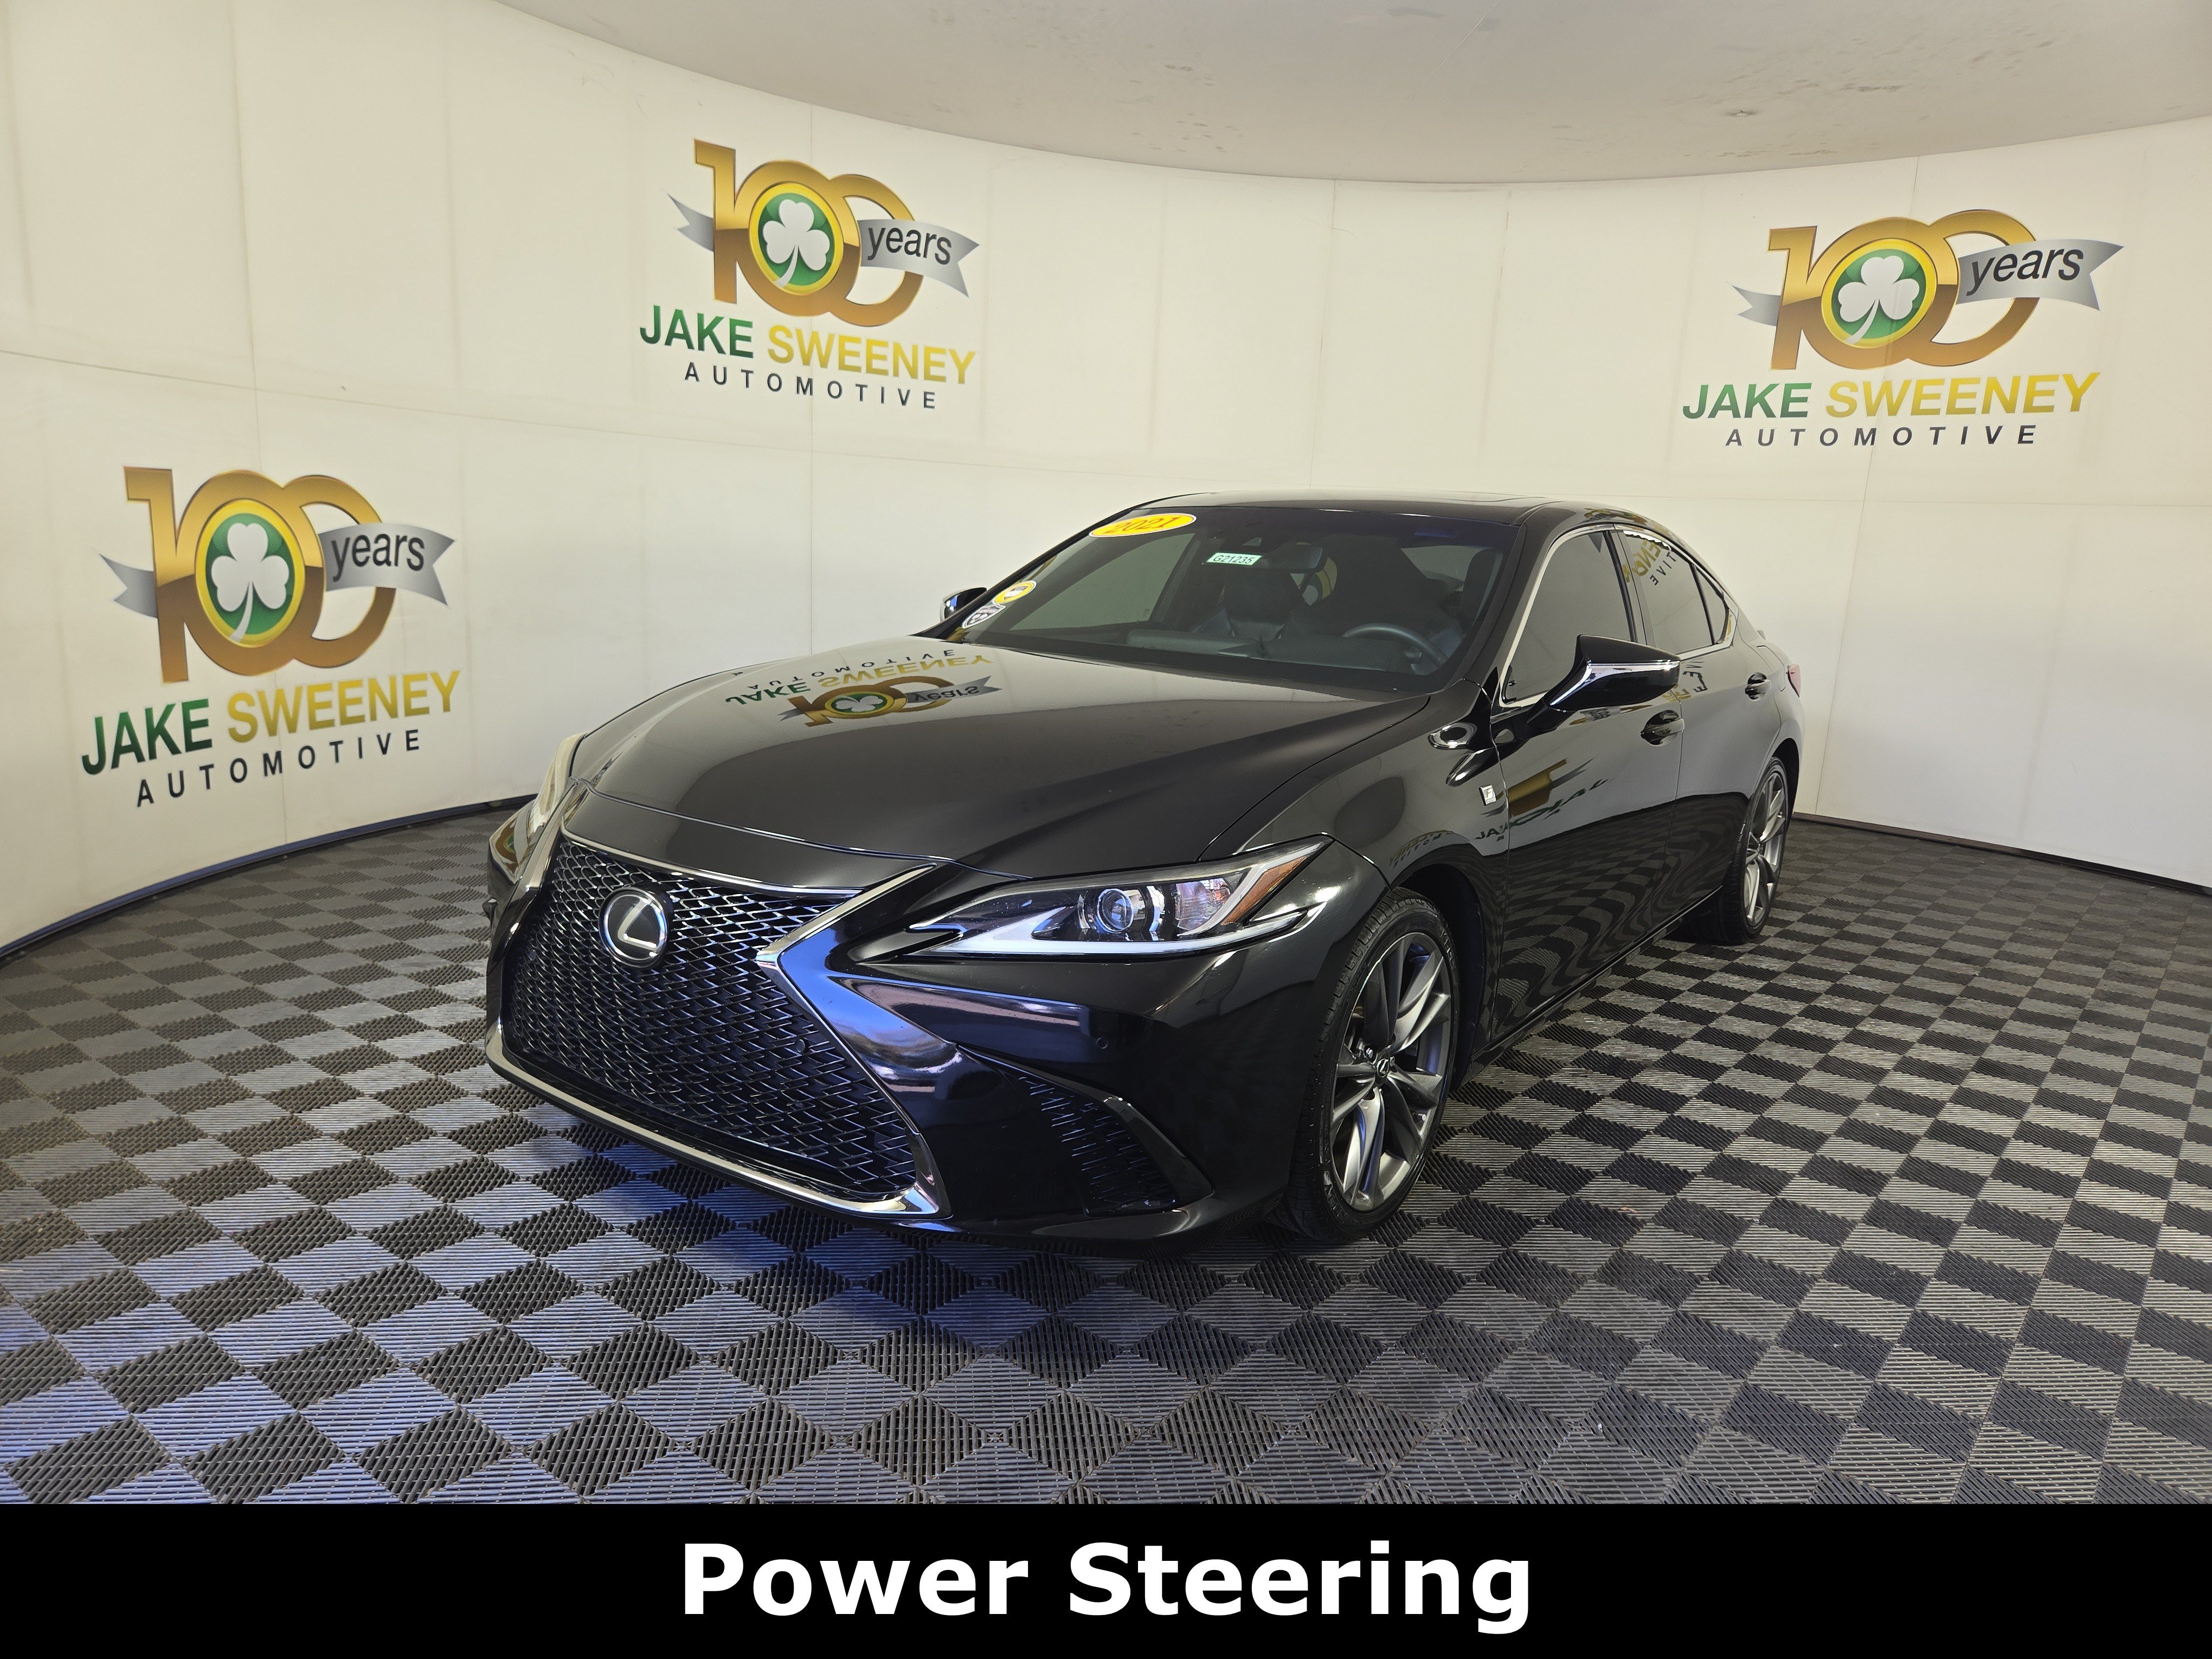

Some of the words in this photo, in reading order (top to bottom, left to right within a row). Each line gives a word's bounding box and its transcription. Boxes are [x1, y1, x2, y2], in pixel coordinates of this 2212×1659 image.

[867, 226, 952, 266] years
[1966, 248, 2084, 296] years
[640, 305, 754, 359] JAKE
[768, 325, 976, 384] SWEENEY
[684, 362, 936, 409] AUTOMOTIVE
[1682, 382, 1812, 419] JAKE
[1826, 372, 2101, 417] SWEENEY
[1725, 425, 2036, 447] AUTOMOTIVE
[1102, 516, 1182, 534] 2021
[331, 533, 425, 582] years
[1213, 555, 1255, 564] G21235
[81, 699, 213, 775] JAKE
[227, 670, 460, 743] SWEENEY
[137, 729, 420, 807] AUTOMOTIVE
